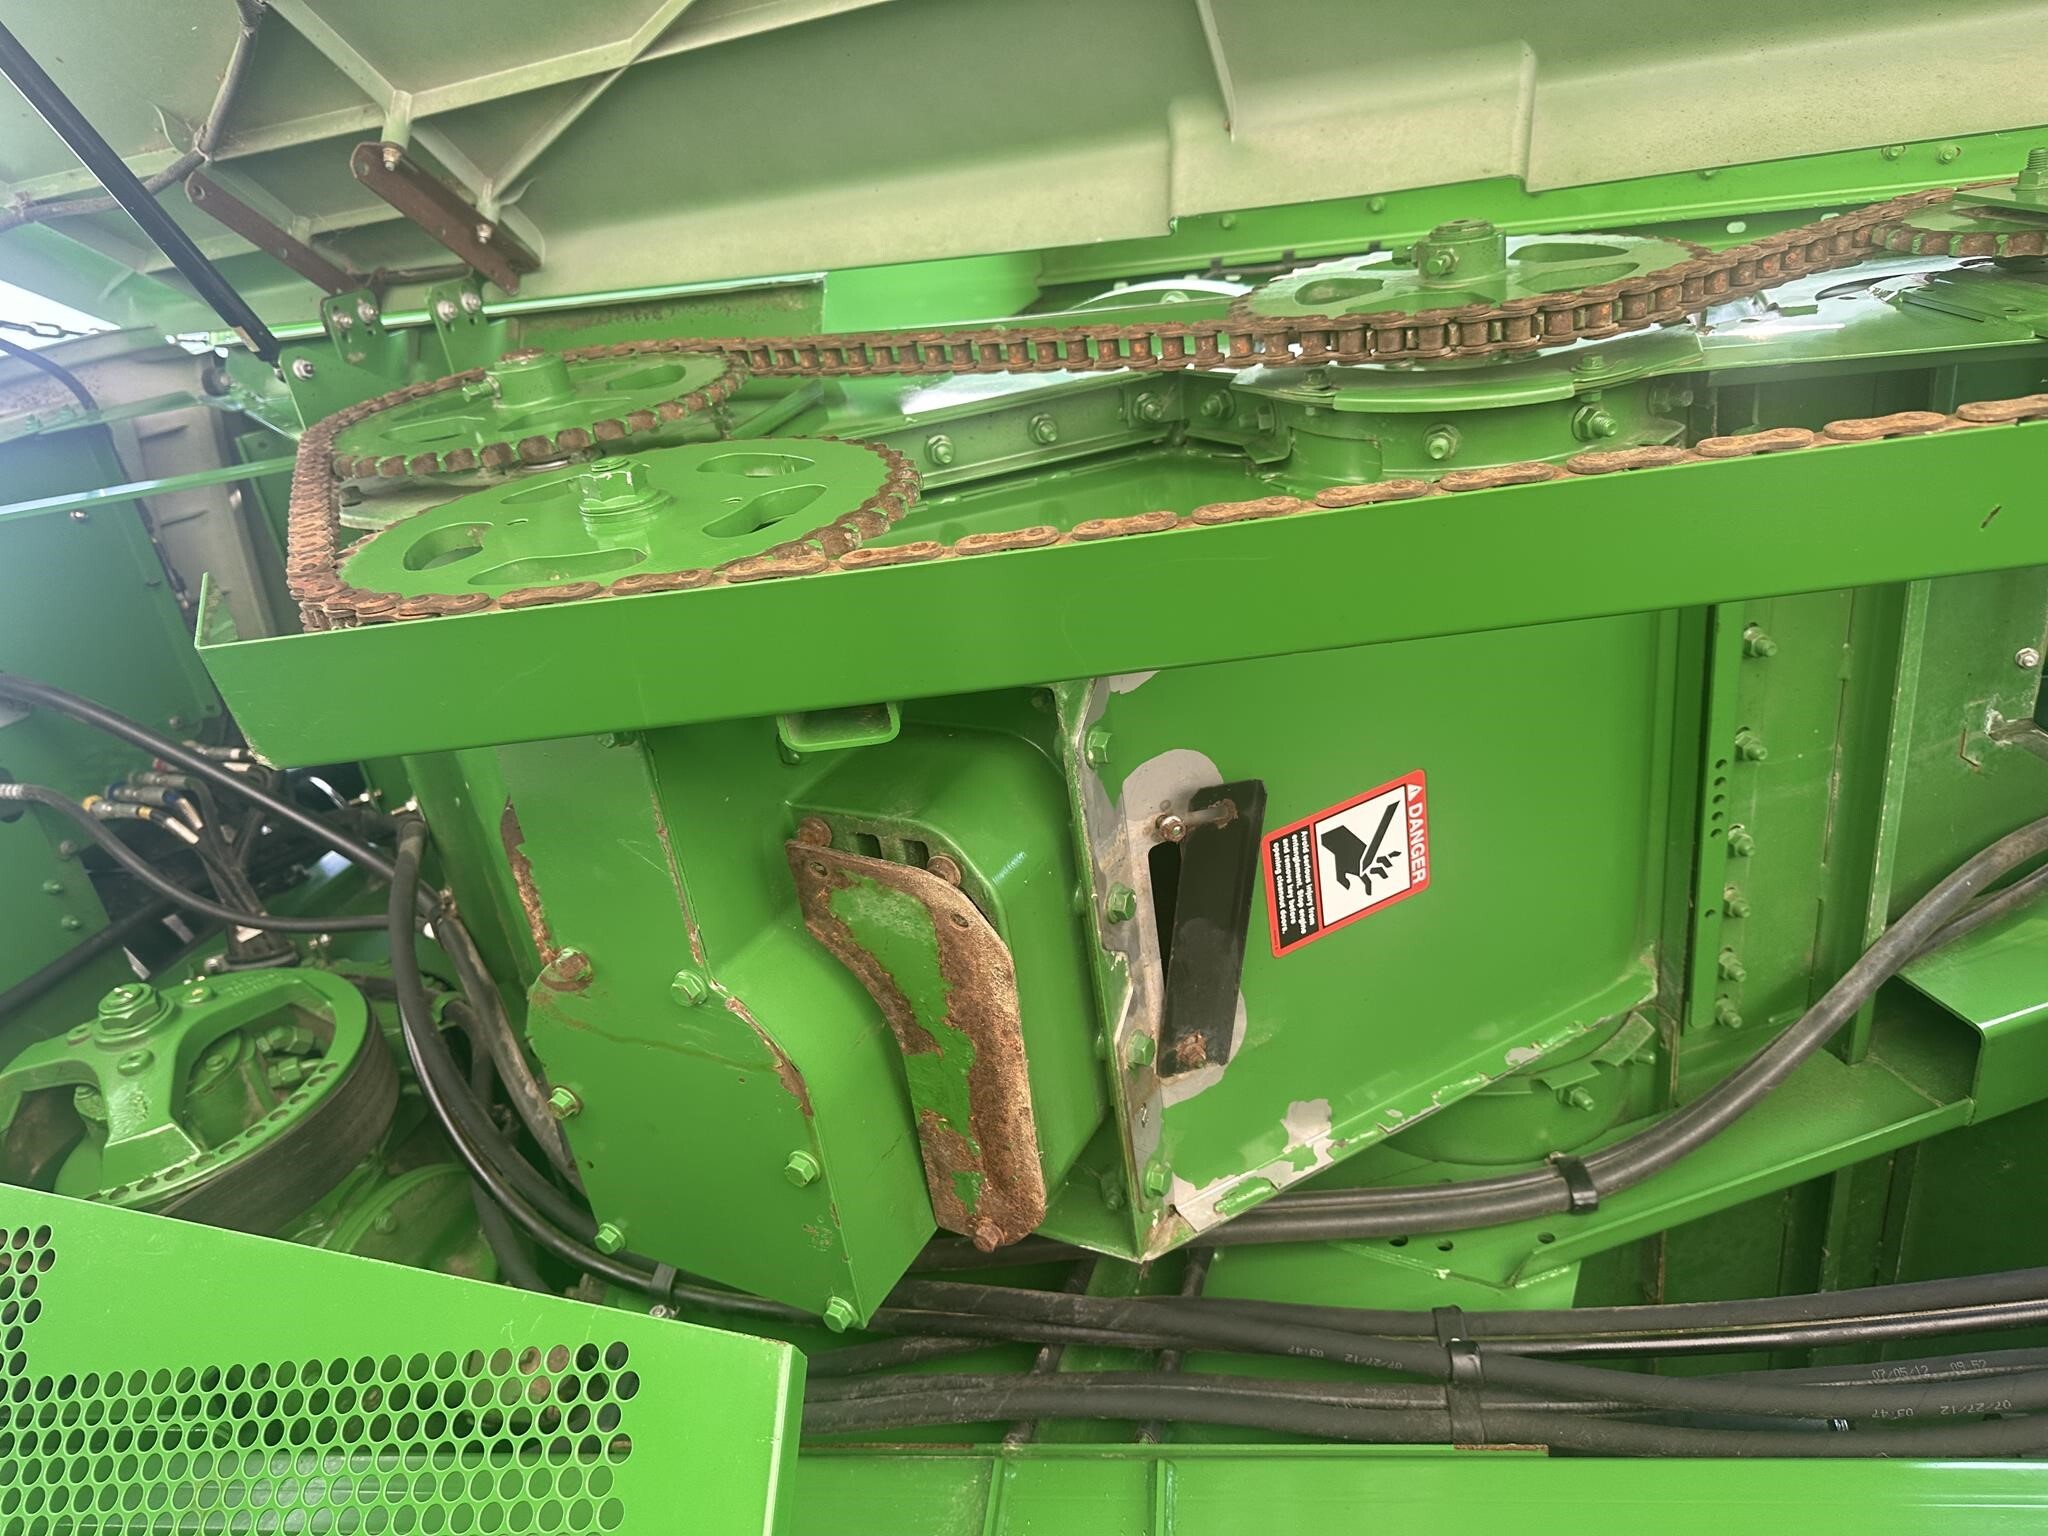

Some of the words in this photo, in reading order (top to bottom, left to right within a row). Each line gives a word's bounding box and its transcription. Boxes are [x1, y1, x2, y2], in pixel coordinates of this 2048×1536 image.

[1282, 838, 1290, 854] and
[1300, 831, 1309, 854] Avoid
[1408, 803, 1427, 883] DANGER
[1273, 841, 1282, 875] opening
[1284, 854, 1292, 884] remove
[1303, 854, 1311, 884] serious
[1277, 874, 1285, 909] cleanout
[1291, 833, 1302, 889] entanglement.
[1298, 908, 1306, 935] engine
[1305, 883, 1313, 907] injury
[1288, 899, 1297, 925] before
